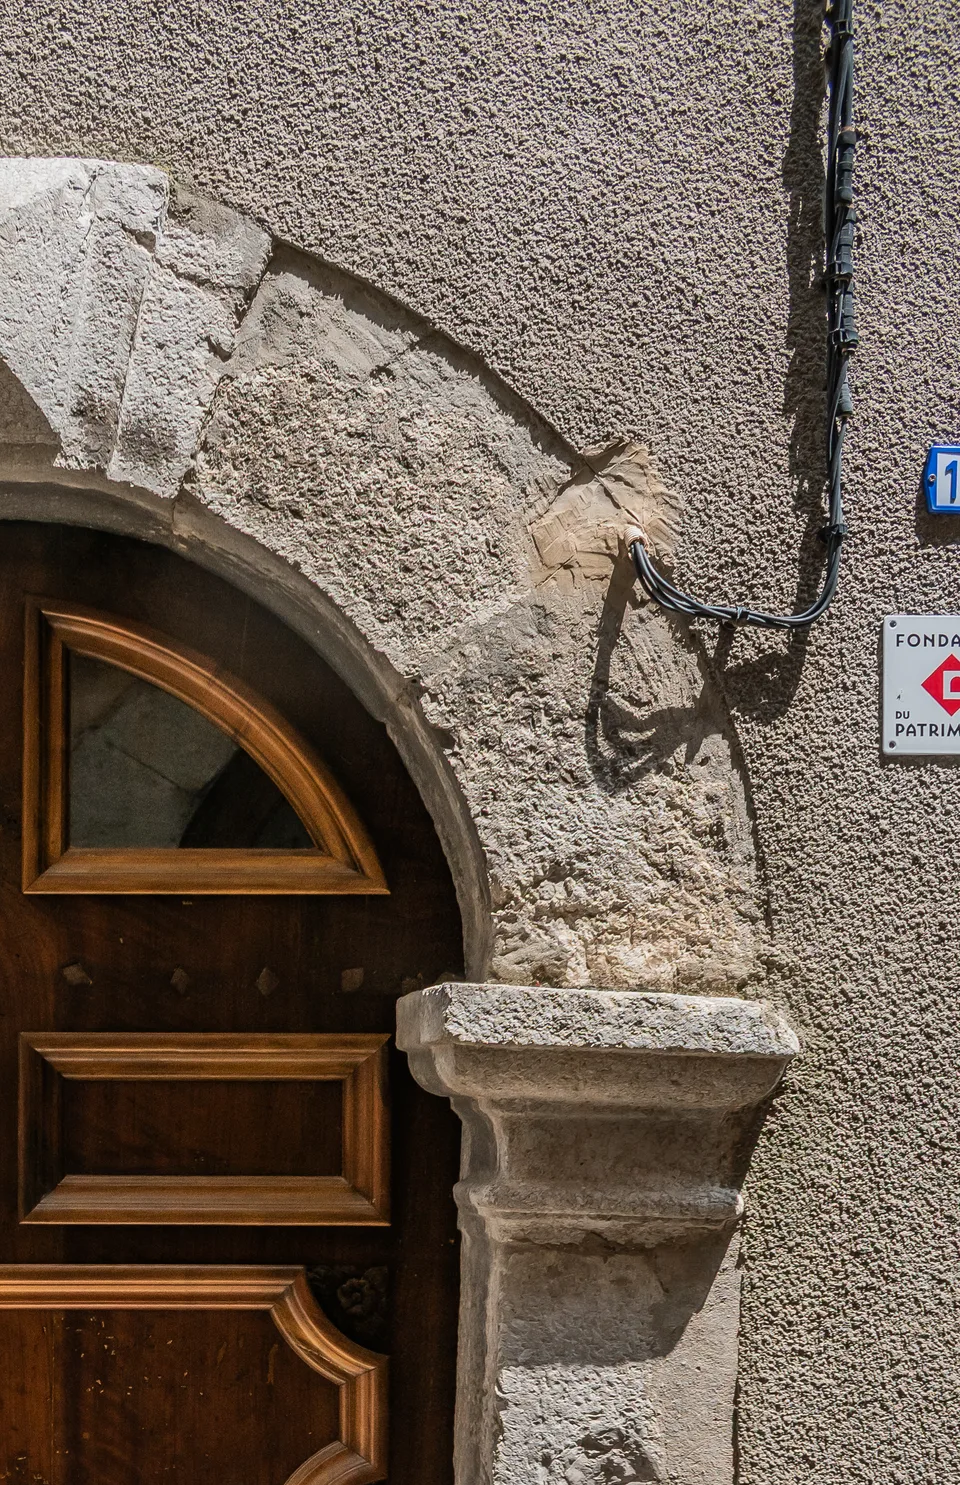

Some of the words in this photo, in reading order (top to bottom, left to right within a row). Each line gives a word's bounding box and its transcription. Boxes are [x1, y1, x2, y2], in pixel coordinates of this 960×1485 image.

[945, 460, 958, 504] 1
[896, 633, 960, 648] FONDA
[895, 710, 910, 720] DU
[895, 723, 960, 737] PATRIM
